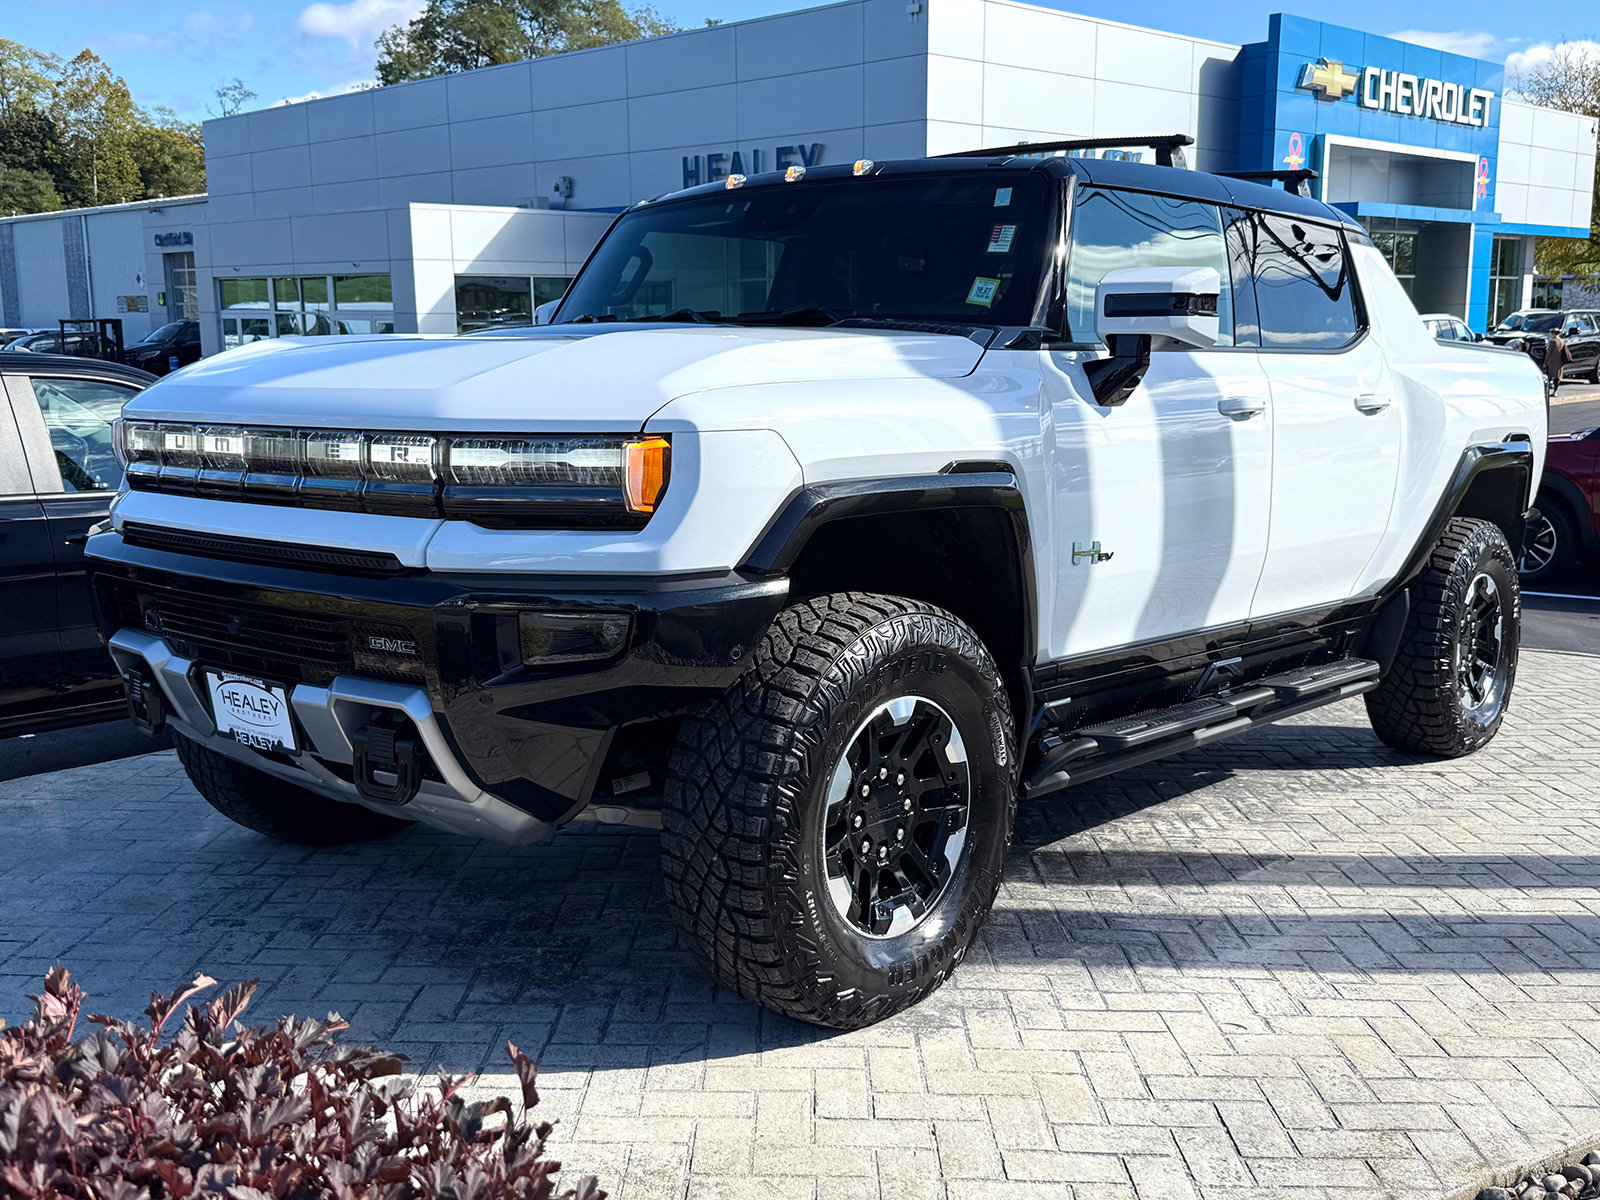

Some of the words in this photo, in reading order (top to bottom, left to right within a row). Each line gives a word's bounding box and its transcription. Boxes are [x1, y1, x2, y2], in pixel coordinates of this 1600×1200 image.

[1363, 66, 1495, 127] CHEVROLET
[369, 636, 416, 654] GMC
[221, 689, 279, 717] HEALEY
[232, 707, 272, 722] BROTHERS
[235, 731, 273, 751] HEALEY
